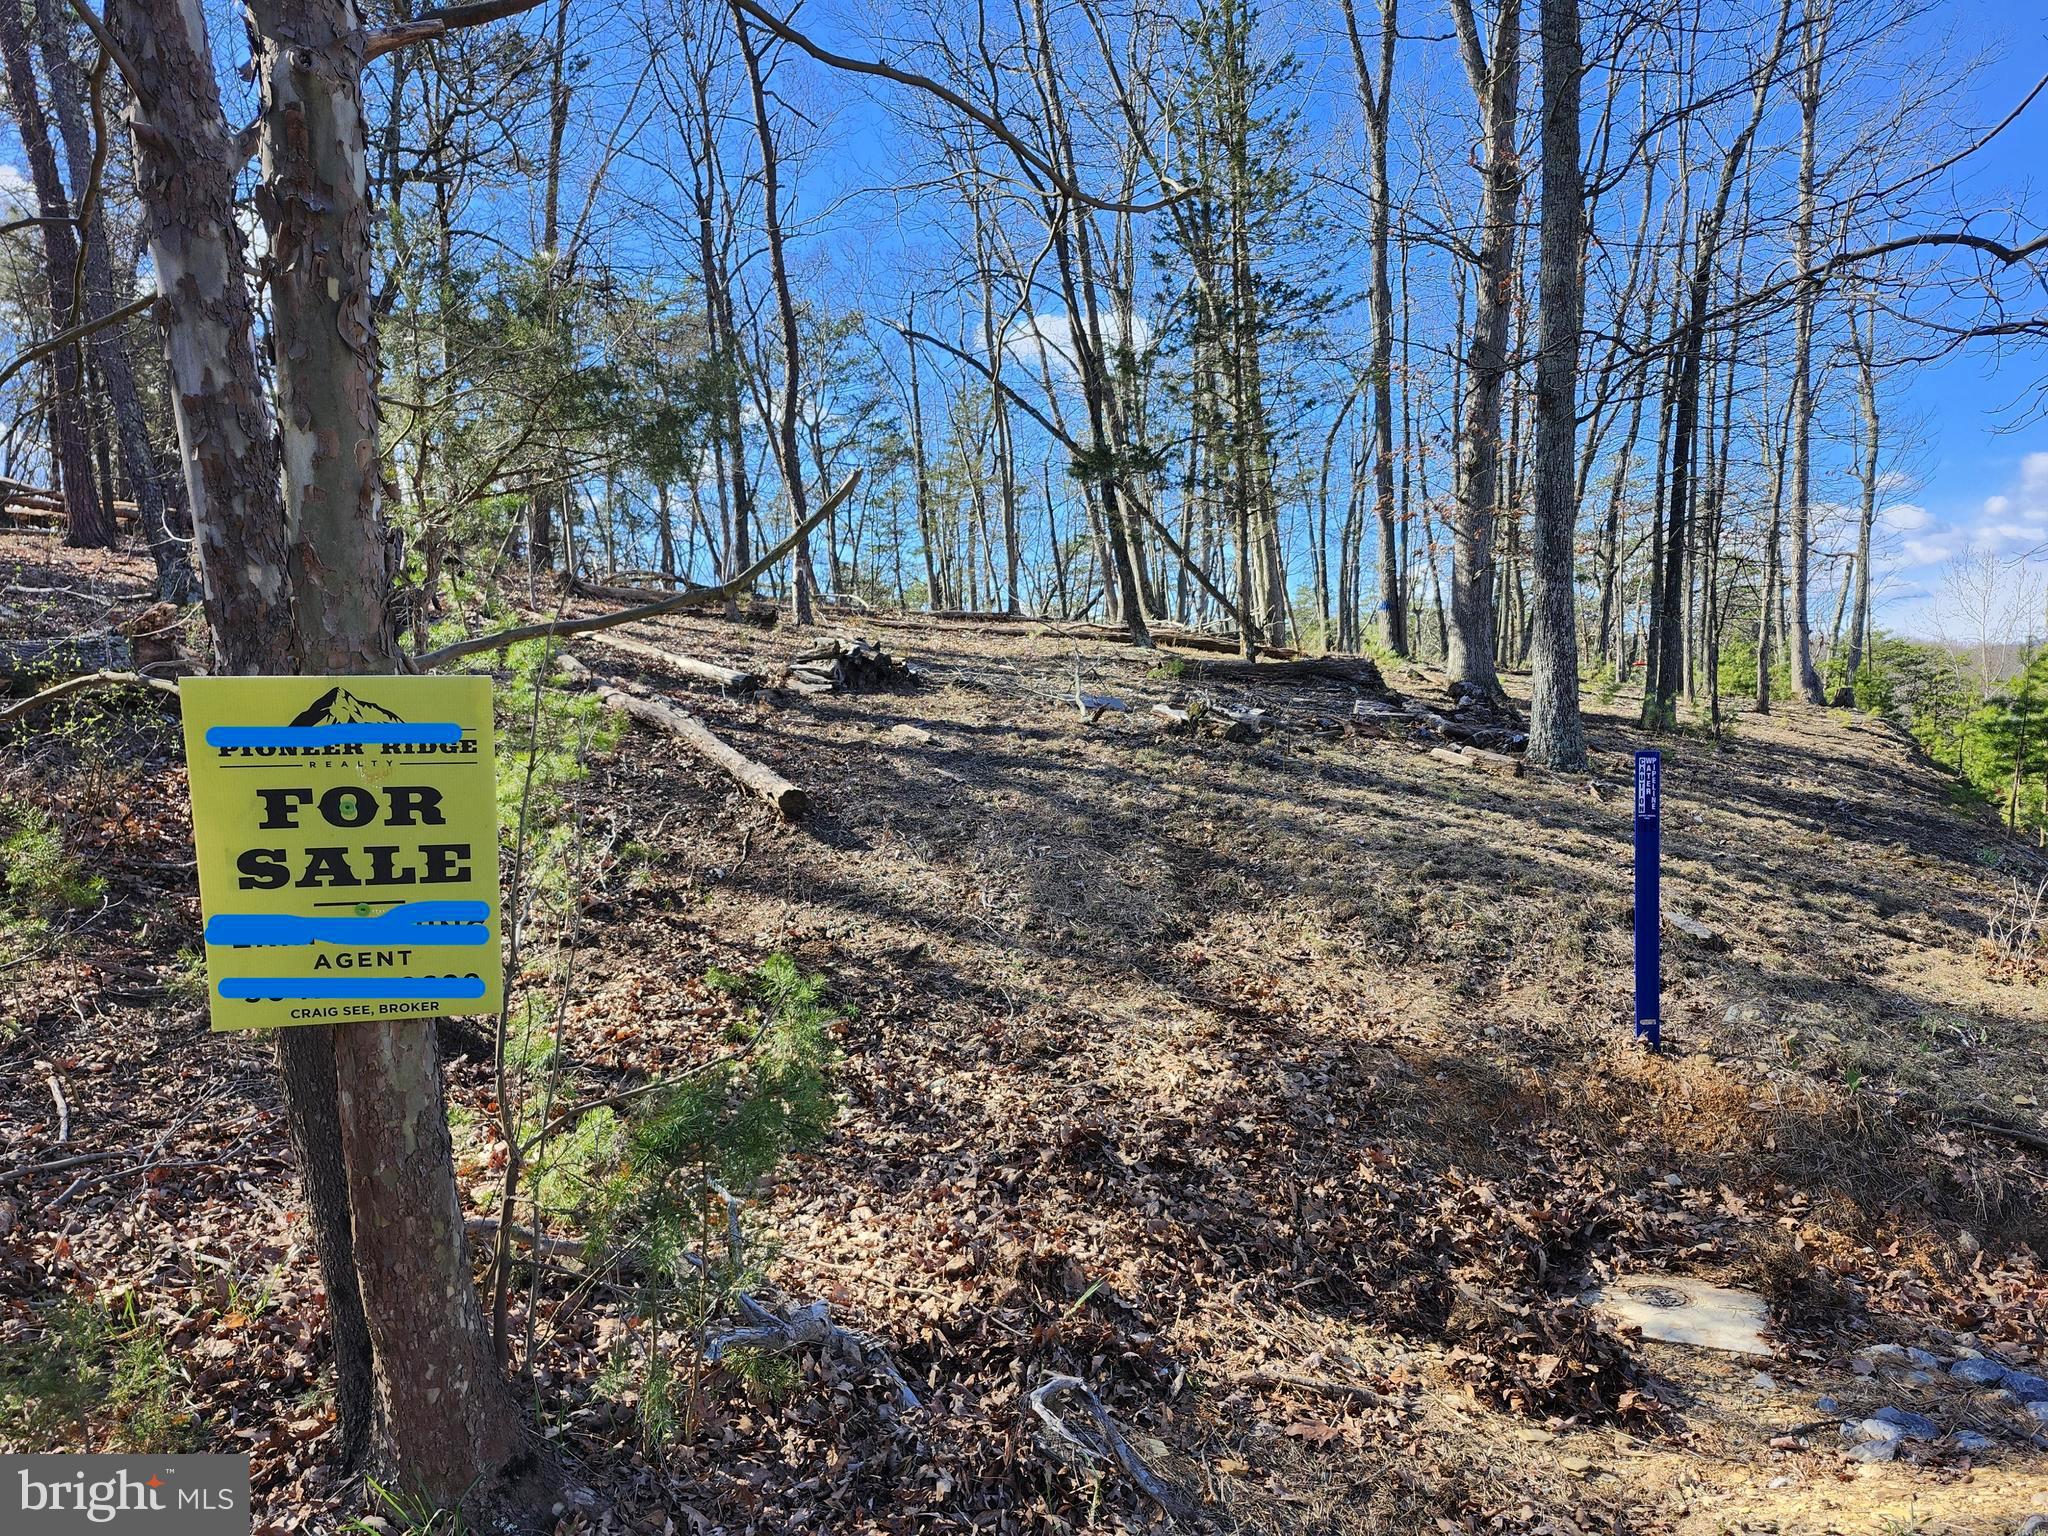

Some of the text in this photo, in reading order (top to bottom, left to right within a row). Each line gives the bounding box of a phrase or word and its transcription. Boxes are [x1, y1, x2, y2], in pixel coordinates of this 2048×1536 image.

[218, 739, 478, 757] PIONEER RIDGE
[309, 760, 394, 768] REALTY
[256, 786, 446, 829] FOR
[236, 843, 472, 889] SALE
[313, 950, 412, 970] AGENT
[290, 1001, 439, 1019] CRAIG SEE, BROKER
